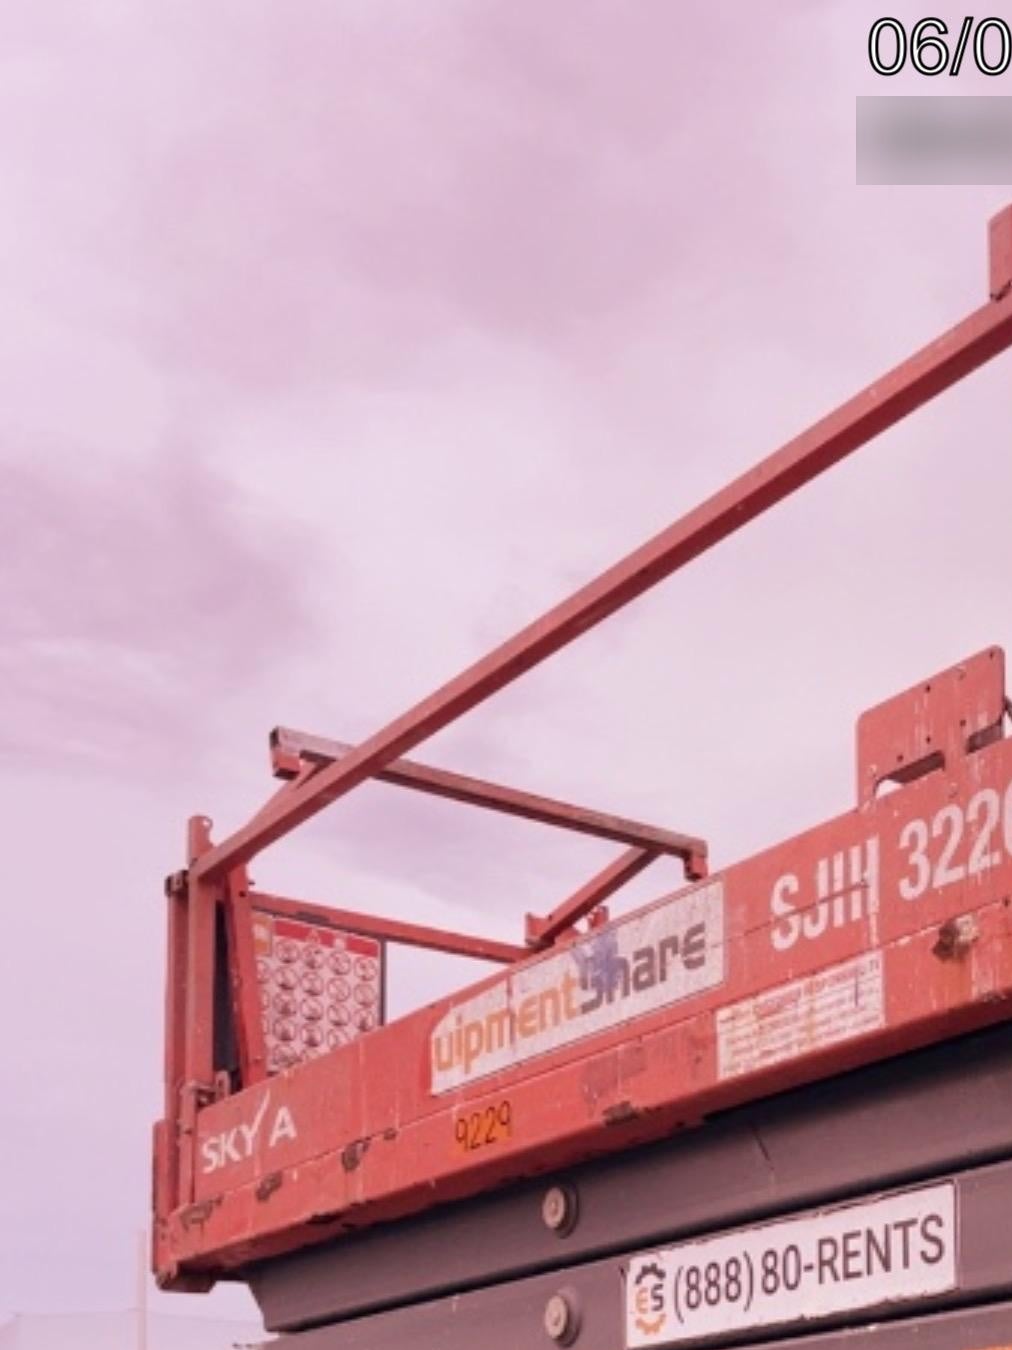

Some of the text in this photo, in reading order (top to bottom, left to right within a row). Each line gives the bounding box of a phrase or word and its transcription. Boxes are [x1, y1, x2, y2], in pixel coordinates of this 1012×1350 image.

[455, 1101, 512, 1151] 9229
[673, 1214, 945, 1323] (888) 80-RENTS
